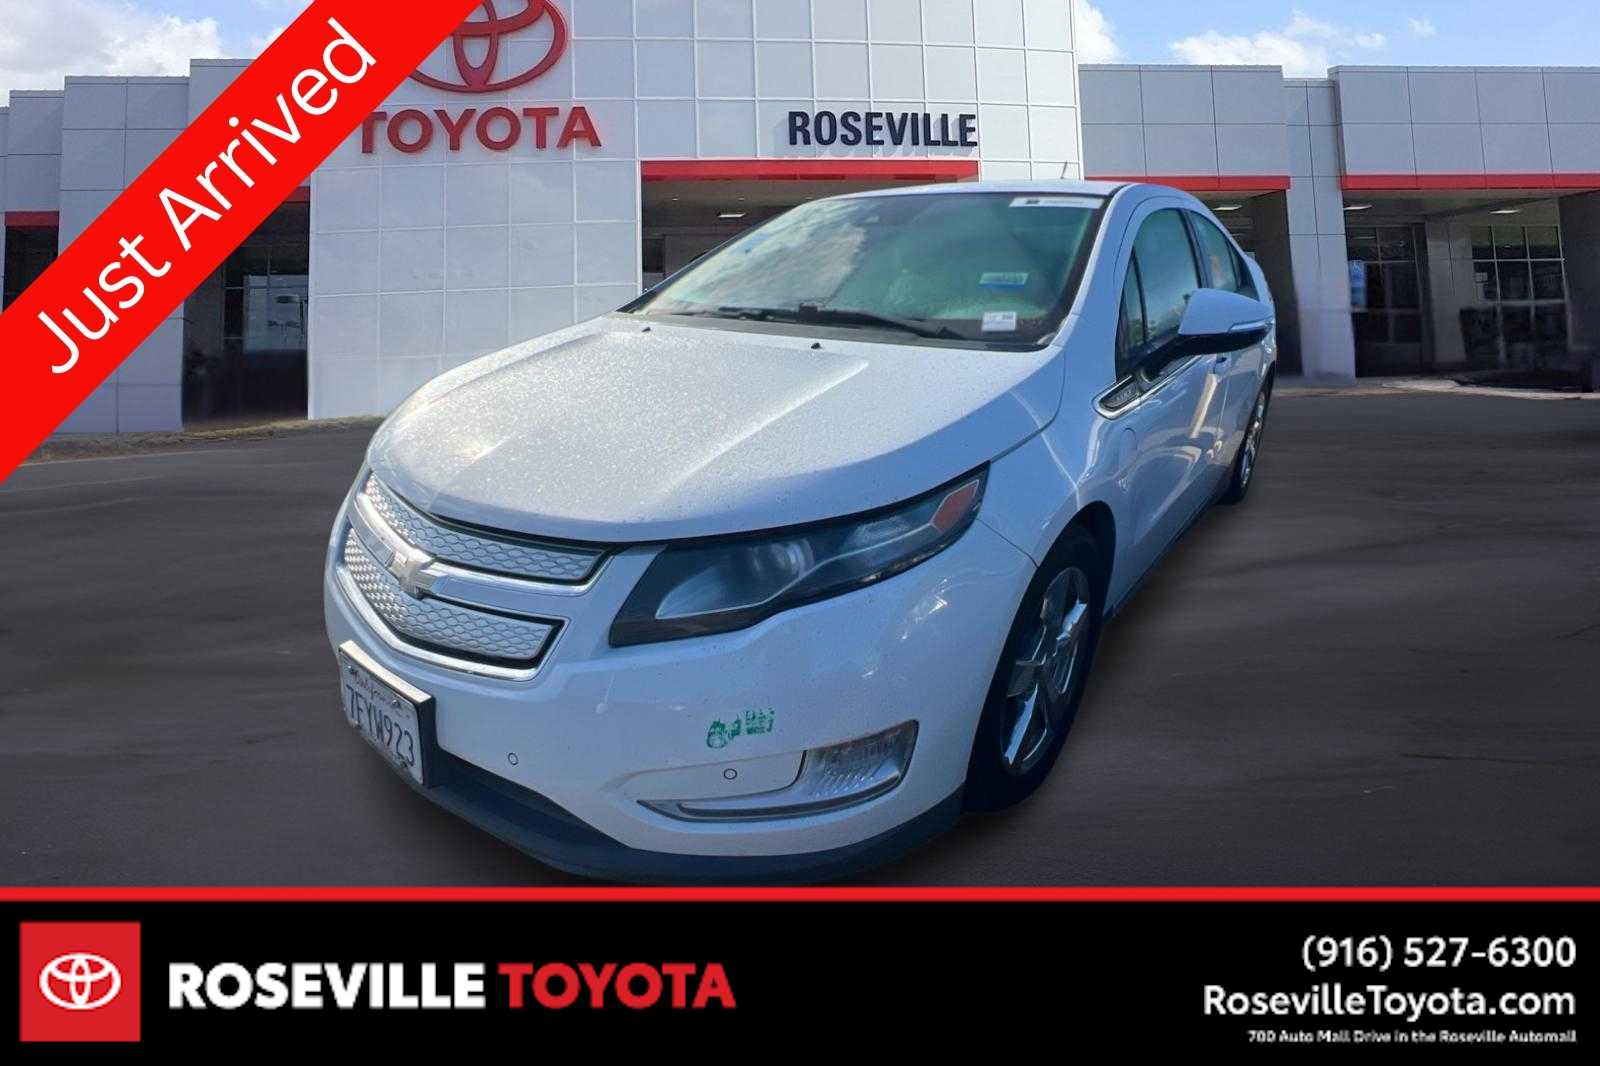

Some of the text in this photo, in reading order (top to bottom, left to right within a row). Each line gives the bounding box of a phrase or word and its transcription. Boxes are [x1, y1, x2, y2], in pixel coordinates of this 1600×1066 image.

[361, 106, 602, 154] TOYOTA
[788, 111, 977, 147] ROSEVILLE
[346, 684, 415, 767] 7FYW923
